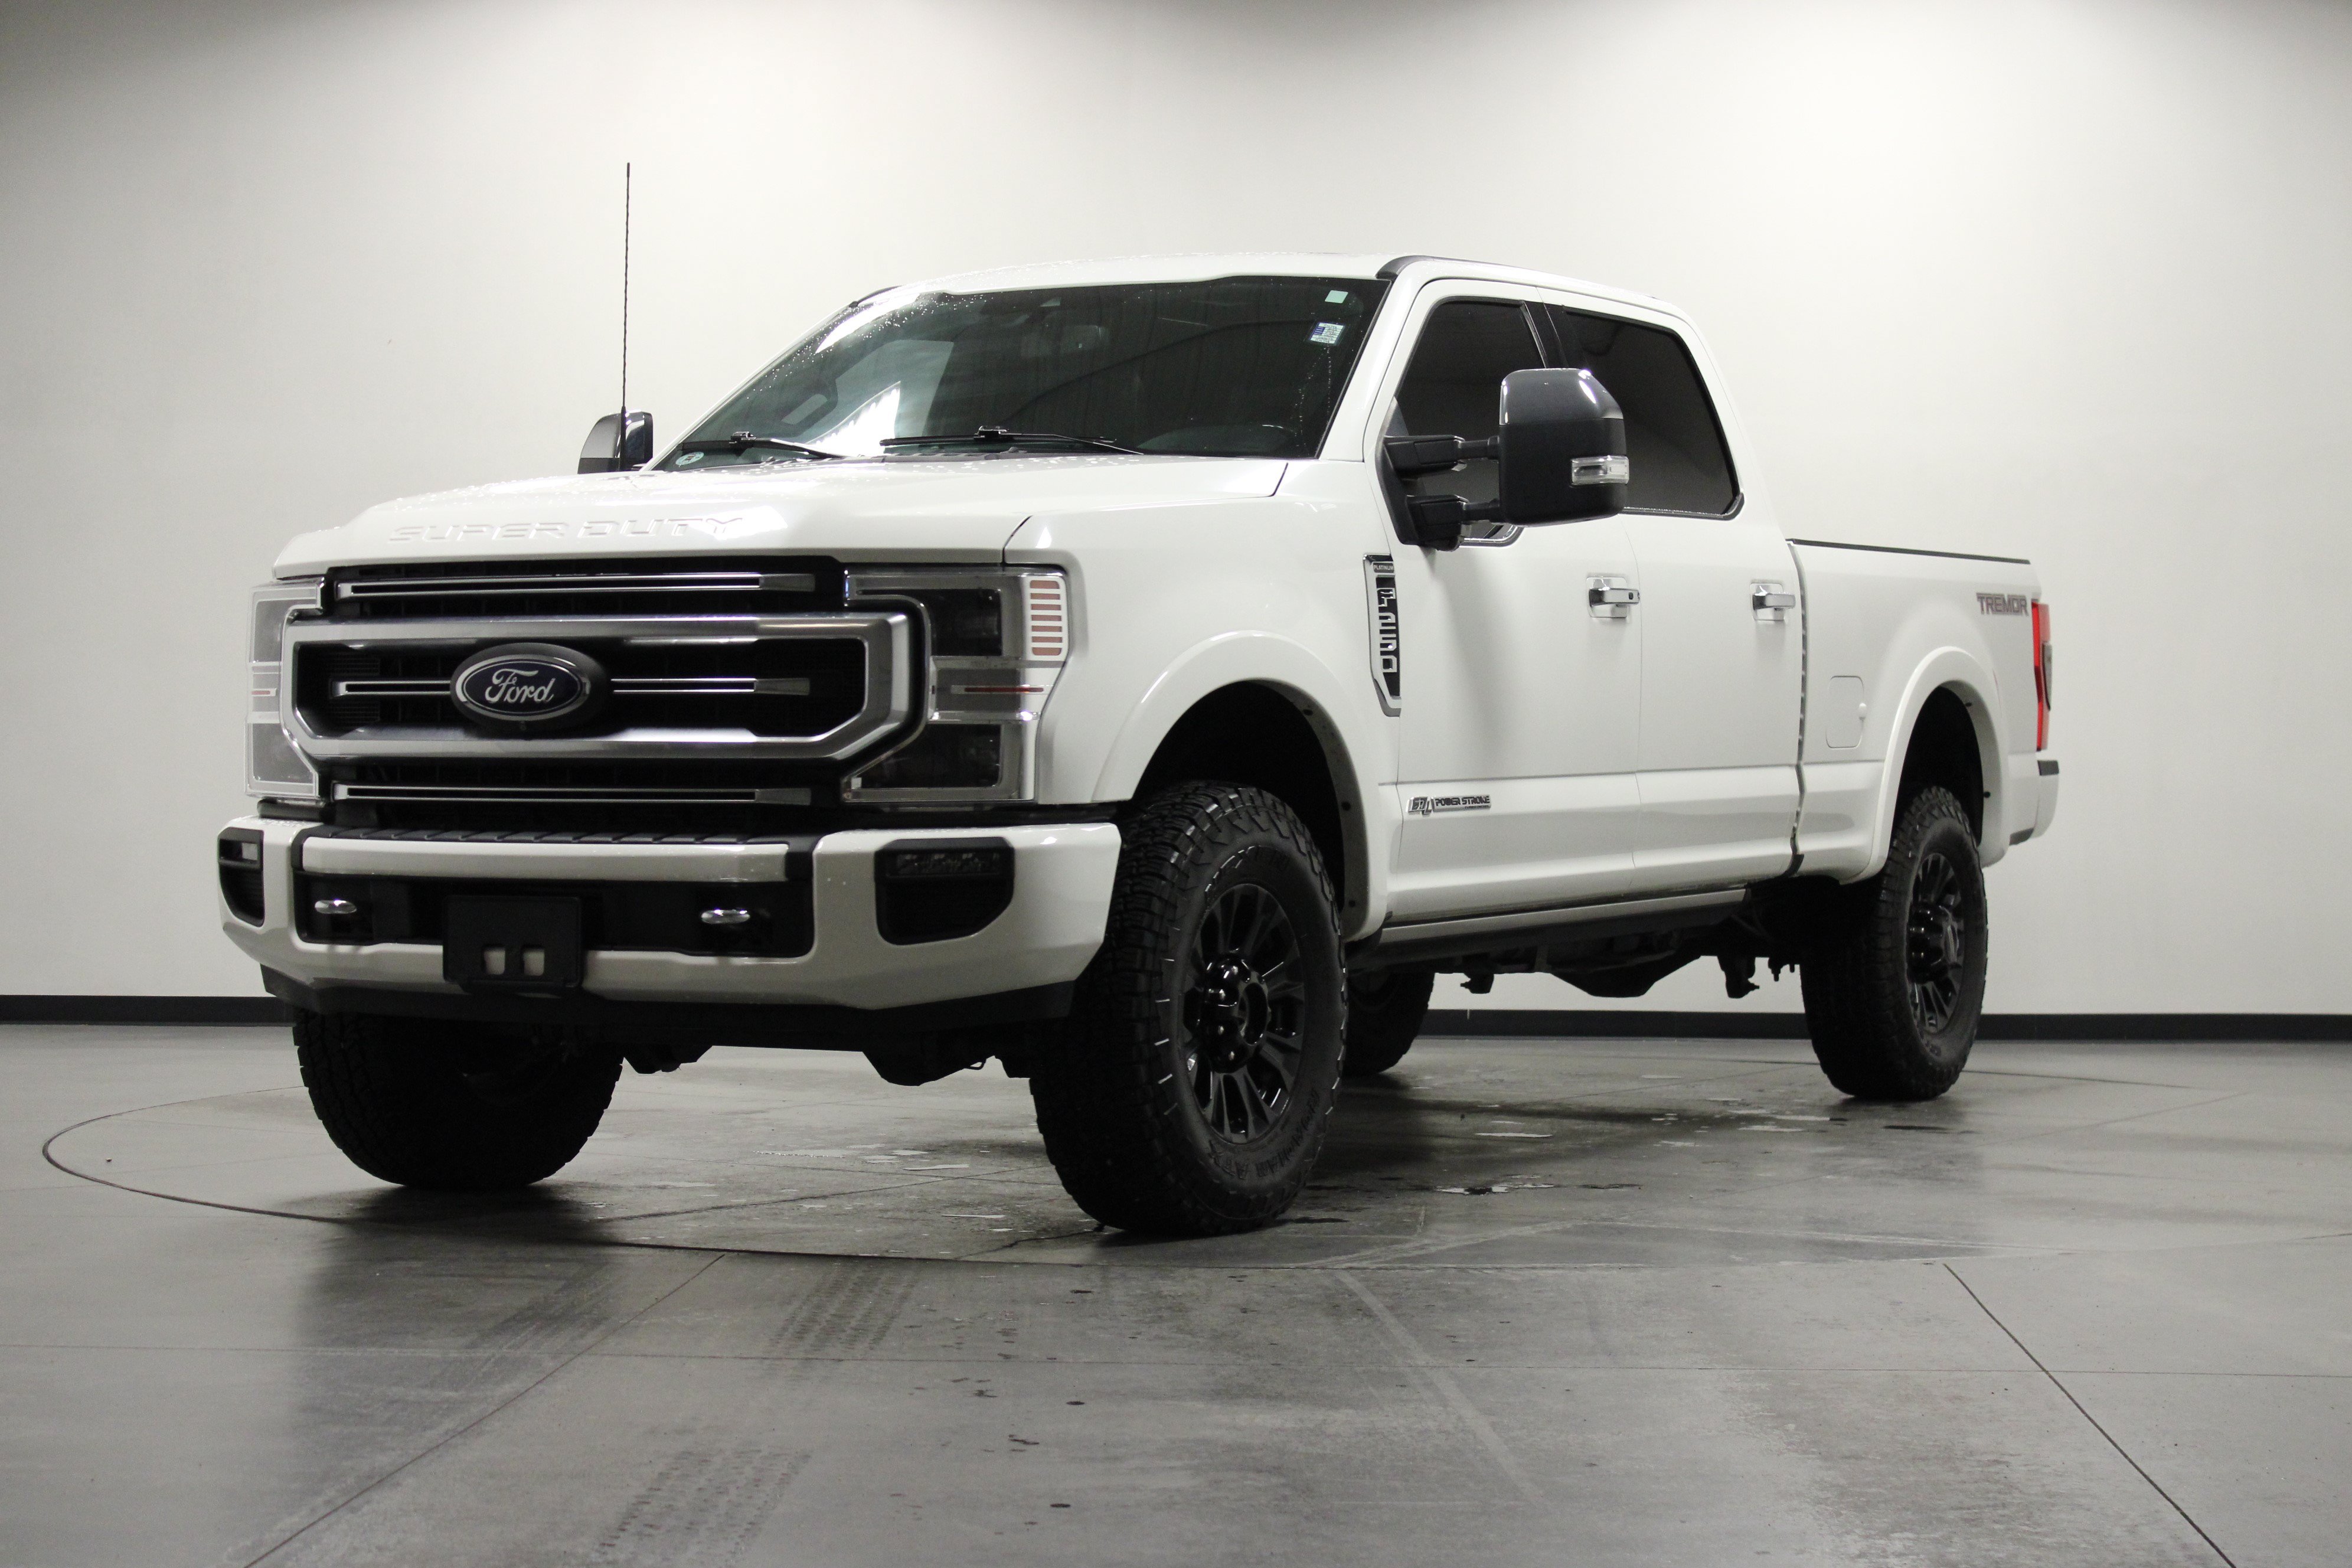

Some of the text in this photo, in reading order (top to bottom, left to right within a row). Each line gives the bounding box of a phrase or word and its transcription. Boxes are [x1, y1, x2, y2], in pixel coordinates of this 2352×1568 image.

[387, 517, 743, 543] SUPER DUTY
[1976, 593, 2029, 616] TREMOR
[484, 668, 556, 704] Ford
[1435, 797, 1461, 806] POWER
[1462, 796, 1490, 805] STROKE
